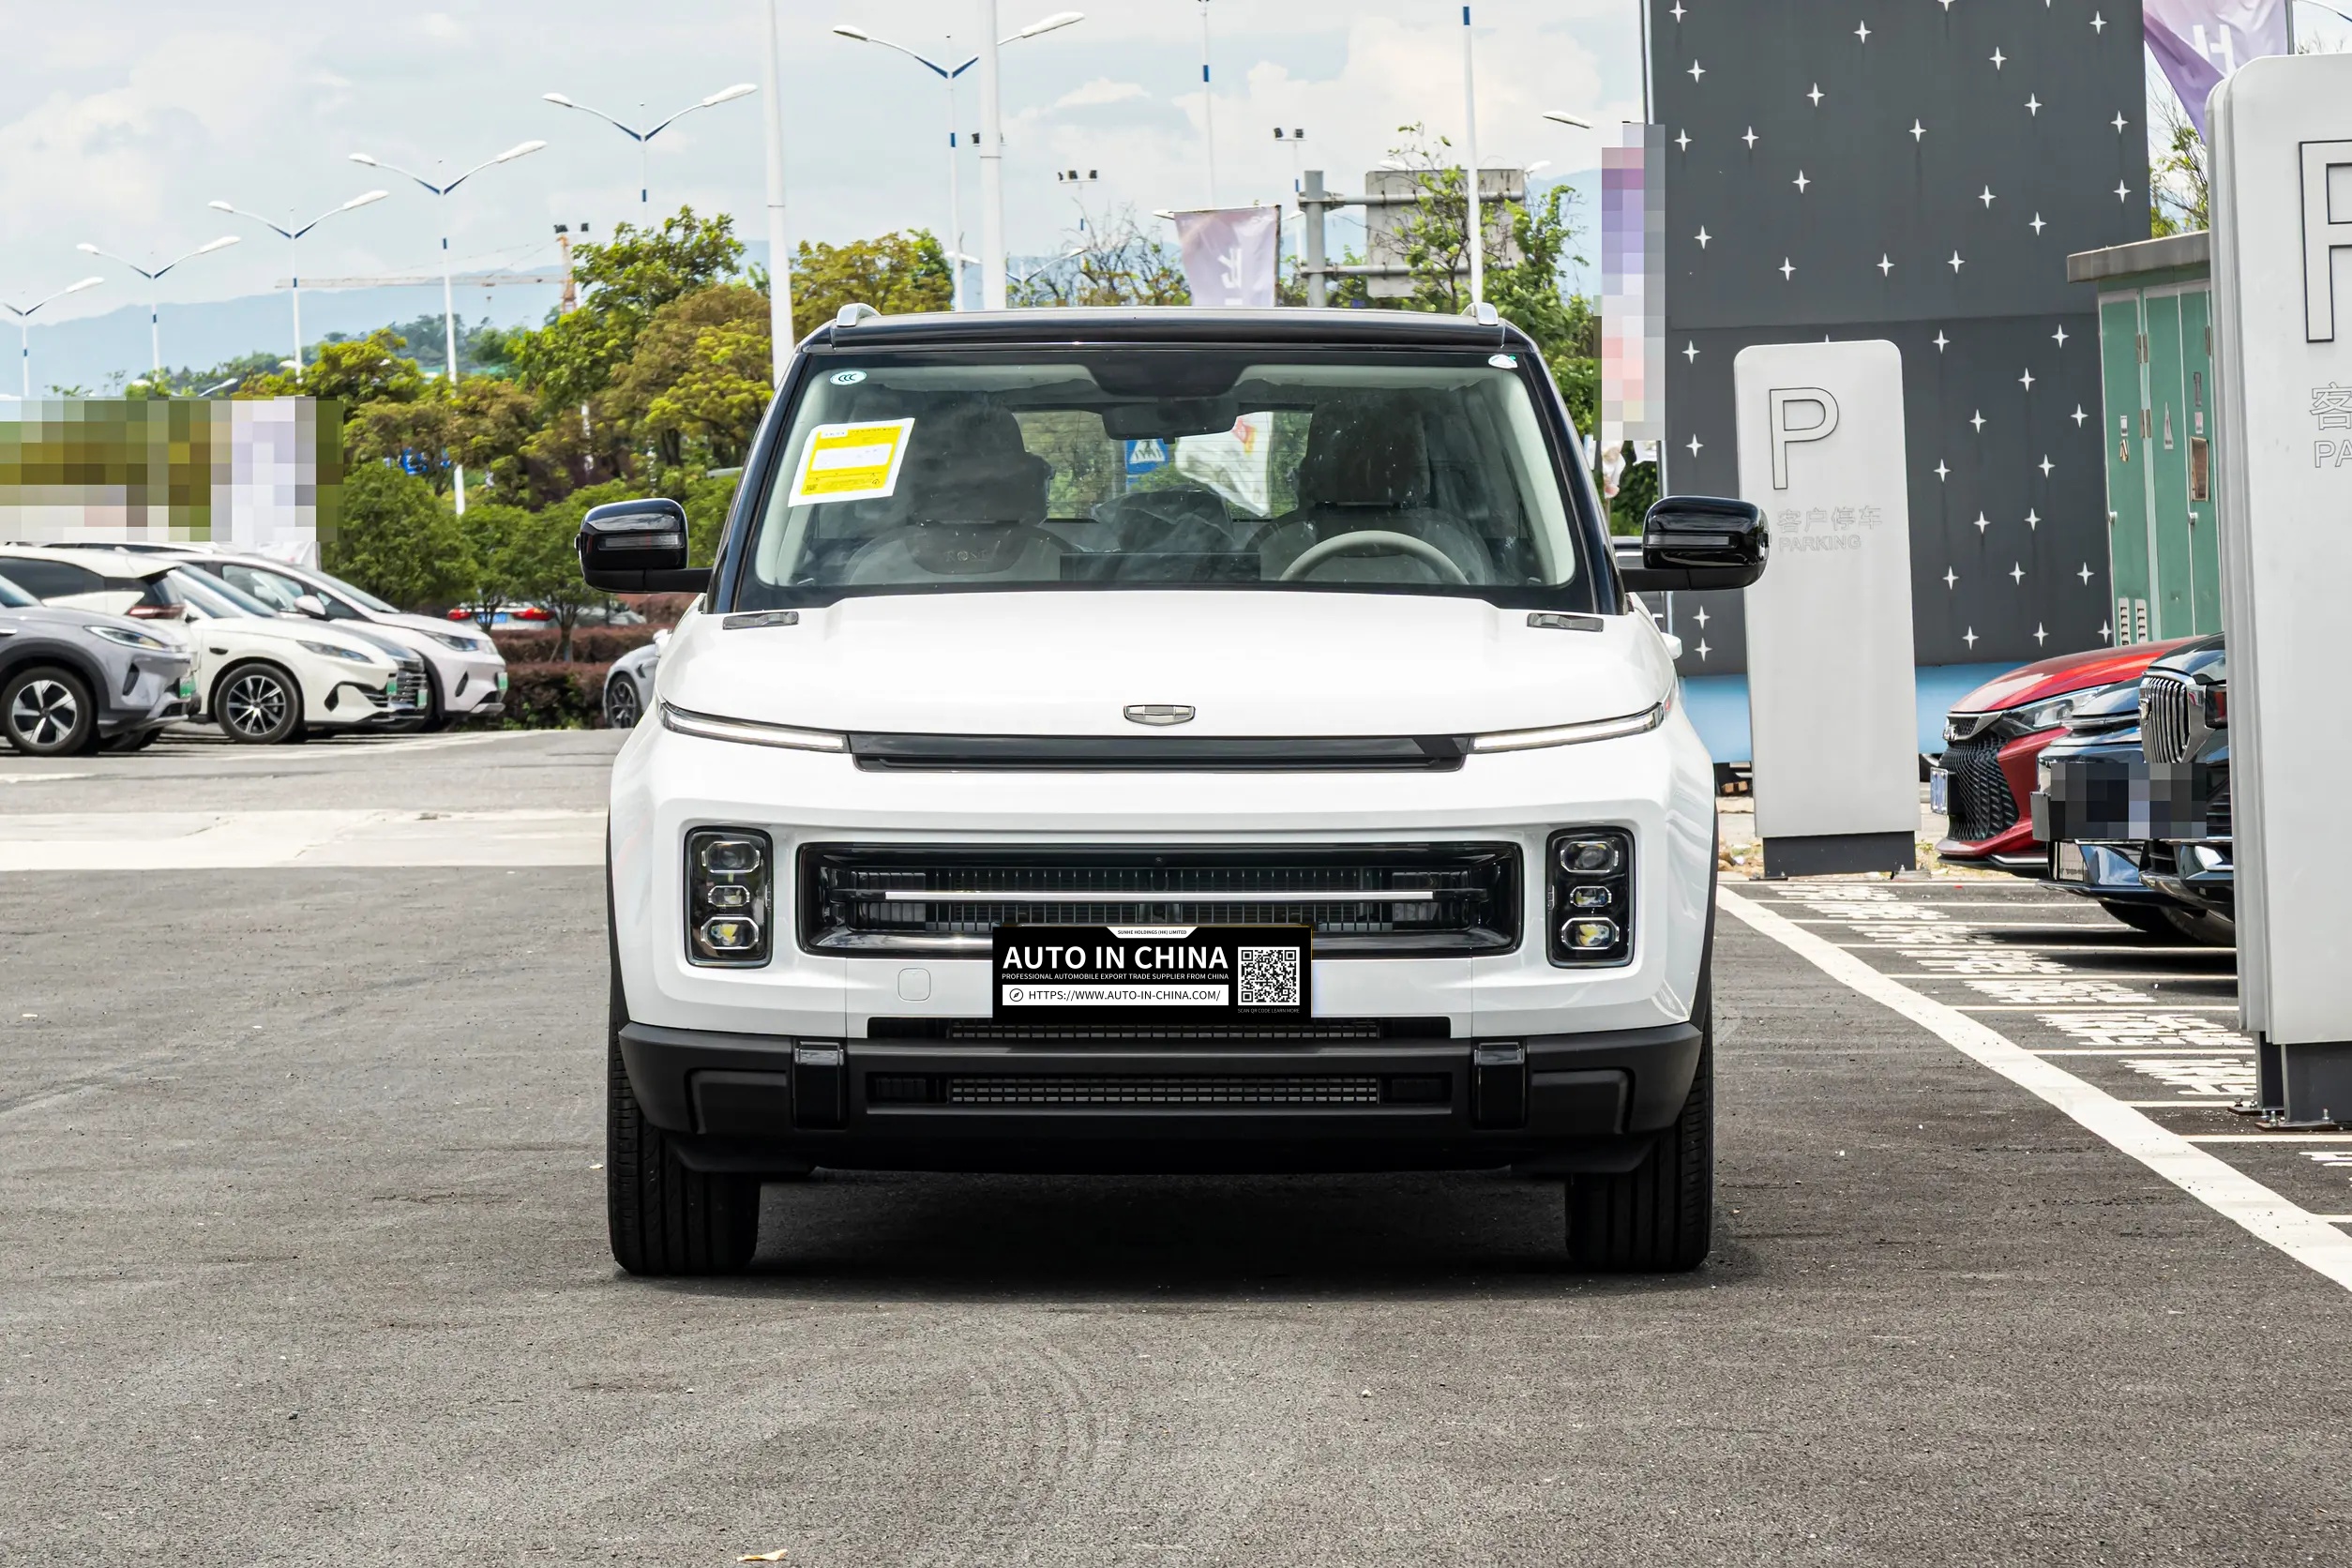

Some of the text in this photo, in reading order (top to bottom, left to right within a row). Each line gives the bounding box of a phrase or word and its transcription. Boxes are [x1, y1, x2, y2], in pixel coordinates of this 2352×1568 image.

[1769, 386, 1839, 490] P
[1776, 505, 1883, 534] 客户停车
[1778, 535, 1862, 552] PARKING
